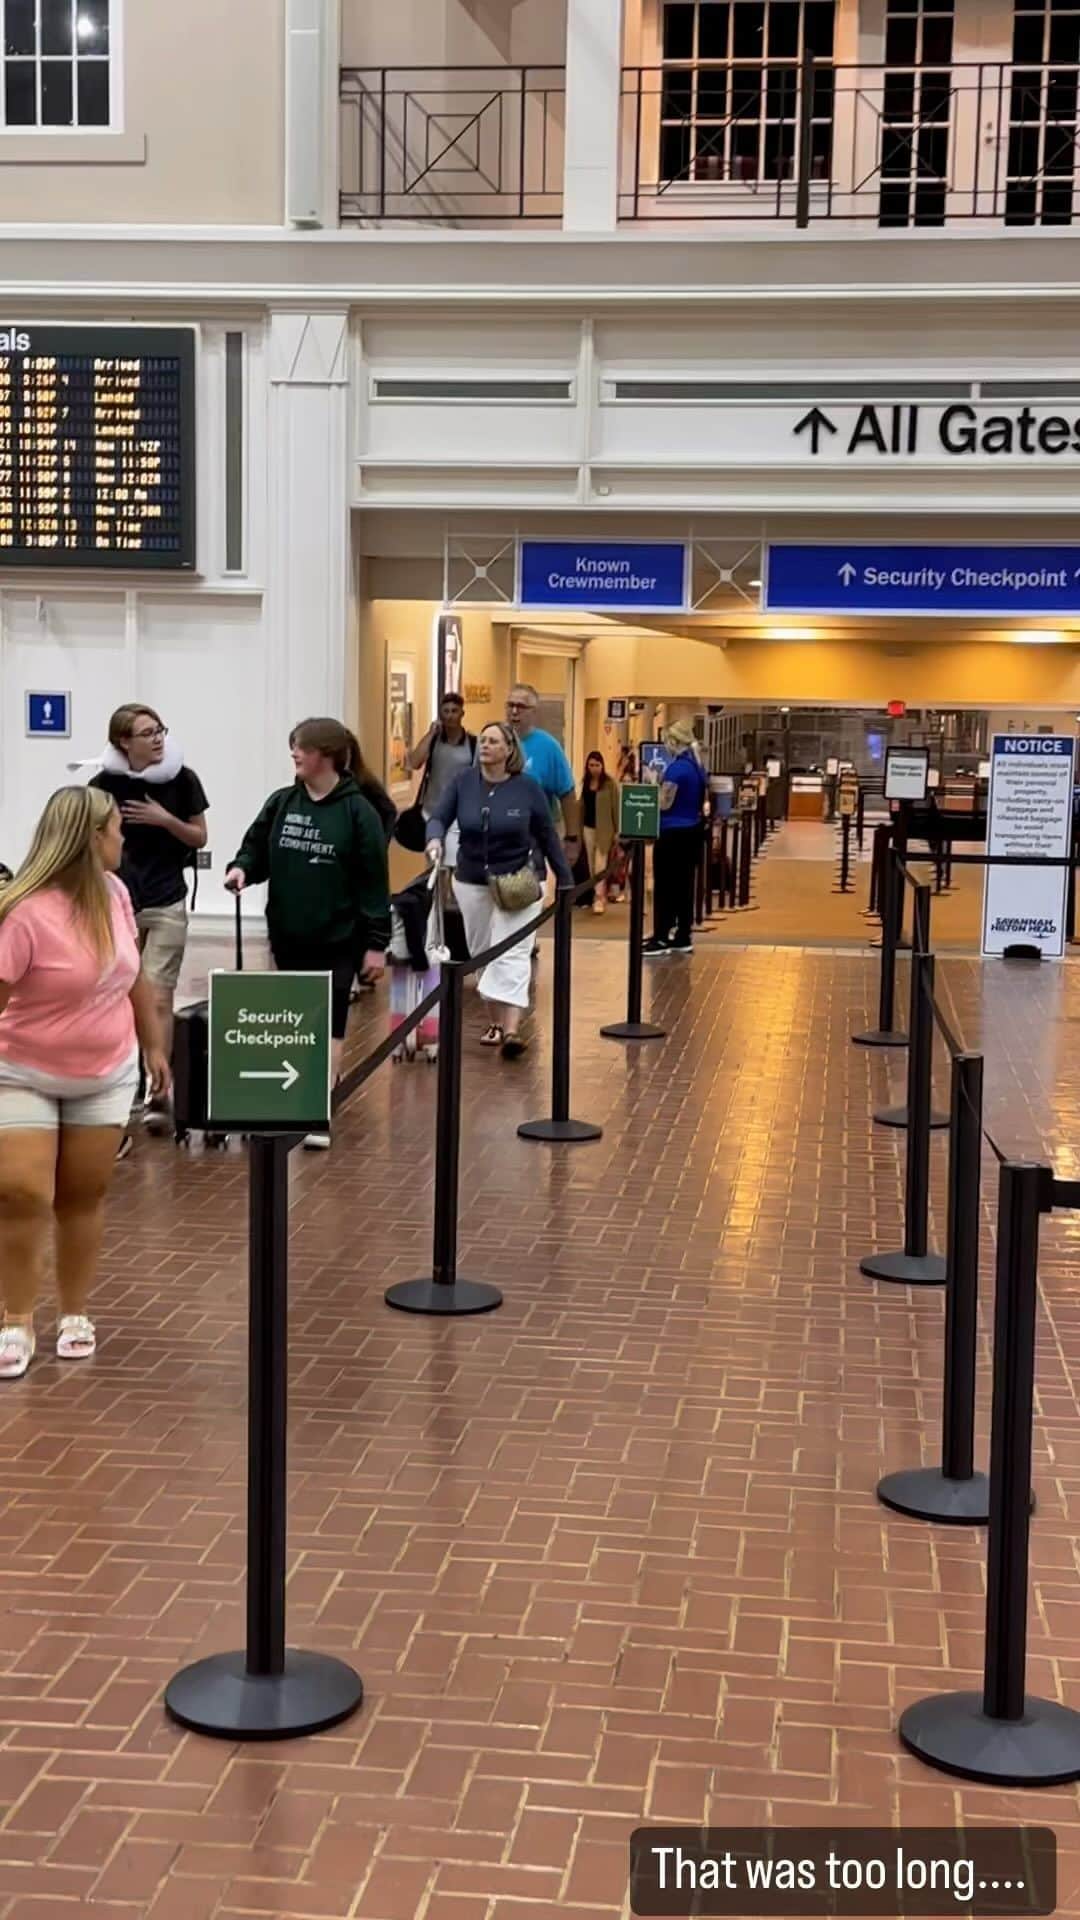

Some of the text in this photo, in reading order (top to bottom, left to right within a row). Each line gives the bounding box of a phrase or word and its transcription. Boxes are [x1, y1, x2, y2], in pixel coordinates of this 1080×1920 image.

[94, 358, 141, 371] Arrived
[94, 374, 141, 388] Arrived
[94, 391, 135, 404] Landed
[94, 407, 142, 420] Arrived
[94, 423, 135, 436] Landed
[847, 404, 918, 454] All
[63, 439, 77, 450] 14
[121, 440, 161, 452] 11:42P
[95, 520, 110, 532] On
[115, 520, 142, 533] Time
[95, 535, 110, 548] On
[115, 535, 143, 549] Time
[575, 556, 631, 573] Known
[548, 573, 657, 590] Crewmember
[863, 567, 1068, 590] Security Checkpoint
[1004, 739, 1063, 753] NOTICE
[990, 924, 1057, 933] HILTON HEAD
[995, 917, 1054, 926] SAVANNAH
[237, 1007, 304, 1028] Security
[224, 1029, 317, 1049] Checkpoint
